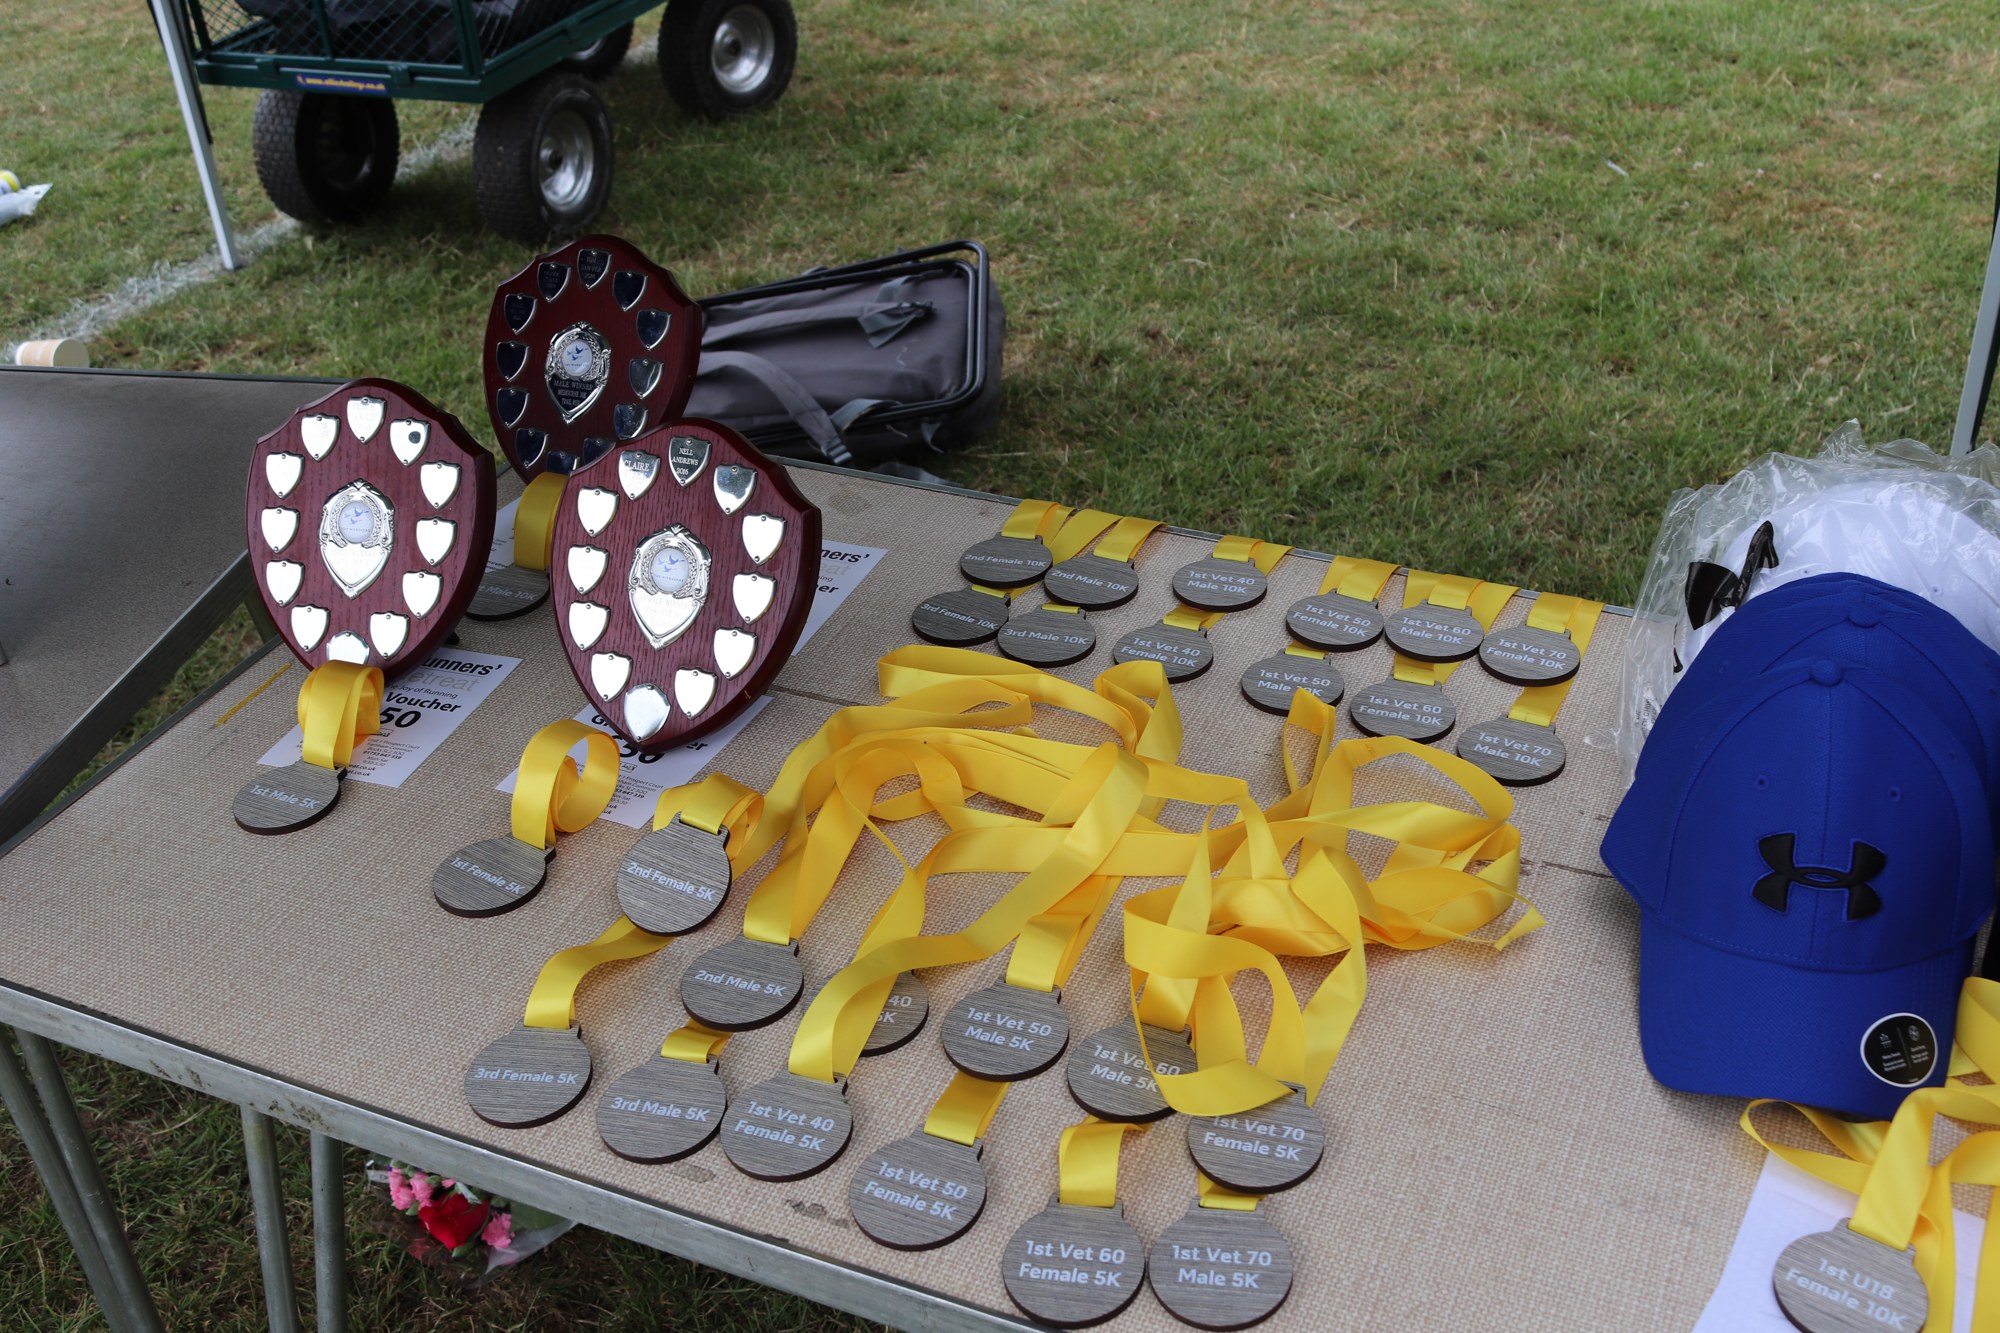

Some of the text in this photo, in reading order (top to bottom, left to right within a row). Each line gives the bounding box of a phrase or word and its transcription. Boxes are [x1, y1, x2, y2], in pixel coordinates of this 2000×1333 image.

[554, 380, 569, 388] MALE
[672, 456, 698, 466] ANDREWS
[679, 447, 693, 456] NELL
[624, 460, 650, 471] CLAIRE
[676, 467, 689, 475] 2016
[821, 548, 870, 563] ners'
[965, 554, 1047, 568] 2nd Female 10K
[1052, 570, 1130, 593] 2nd Male 10K
[1187, 580, 1247, 594] Male 10K
[1189, 570, 1255, 585] 1st Vet 40
[487, 585, 512, 597] Male
[514, 591, 539, 601] 10K
[921, 603, 999, 630] 3rd Female 10K
[1293, 611, 1369, 637] Female 10K
[1306, 604, 1372, 627] 1st Vet 50
[1403, 616, 1472, 636] 1st Vet 60
[1004, 628, 1090, 645] 3rd Male 10K
[1400, 626, 1463, 645] Male 10K
[1121, 645, 1199, 667] Female 10K
[1134, 637, 1200, 657] 1st Vet 40
[1486, 646, 1567, 670] Female 10K
[1499, 639, 1567, 660] 1st Vet 70
[422, 657, 503, 676] unners'
[408, 671, 480, 692] etreat
[1258, 680, 1291, 693] Male
[1260, 669, 1331, 687] 1st Vet 50
[385, 691, 461, 713] Voucher
[423, 688, 458, 699] Running
[1369, 695, 1443, 714] 1st Vet 60
[380, 706, 422, 728] 50
[1359, 705, 1443, 726] Female 10K
[1474, 743, 1542, 767] Male 10K
[1479, 732, 1552, 756] 1st Vet 70
[252, 784, 320, 810] 1st Male 5K
[450, 856, 526, 896] 1st Female 5K
[626, 862, 716, 902] 2nd Female 5K
[695, 969, 789, 998] 2nd Male 5K
[889, 995, 912, 1007] 40
[967, 1008, 1052, 1037] 1st Vet 50
[964, 1025, 1035, 1052] Male 5K
[1094, 1045, 1119, 1062] 1st
[1155, 1062, 1181, 1076] 60
[474, 1068, 580, 1085] 3rd Female 5K
[1090, 1063, 1158, 1092] Male 5K
[611, 1096, 711, 1122] 3rd Male 5K
[747, 1101, 835, 1132] 1st Vet 40
[734, 1119, 827, 1151] Female 5K
[1213, 1116, 1305, 1141] 1st Vet 70
[1203, 1131, 1302, 1161] Female 5K
[879, 1161, 968, 1199] 1st Vet 50
[864, 1180, 958, 1221] Female 5K
[1026, 1240, 1126, 1265] 1st Vet 60
[1171, 1244, 1272, 1267] 1st Vet 70
[1019, 1263, 1123, 1288] Female 5K
[1178, 1268, 1260, 1289] Male 5K
[1818, 1257, 1896, 1300] 1st U18
[1785, 1267, 1908, 1332] Female 10K
